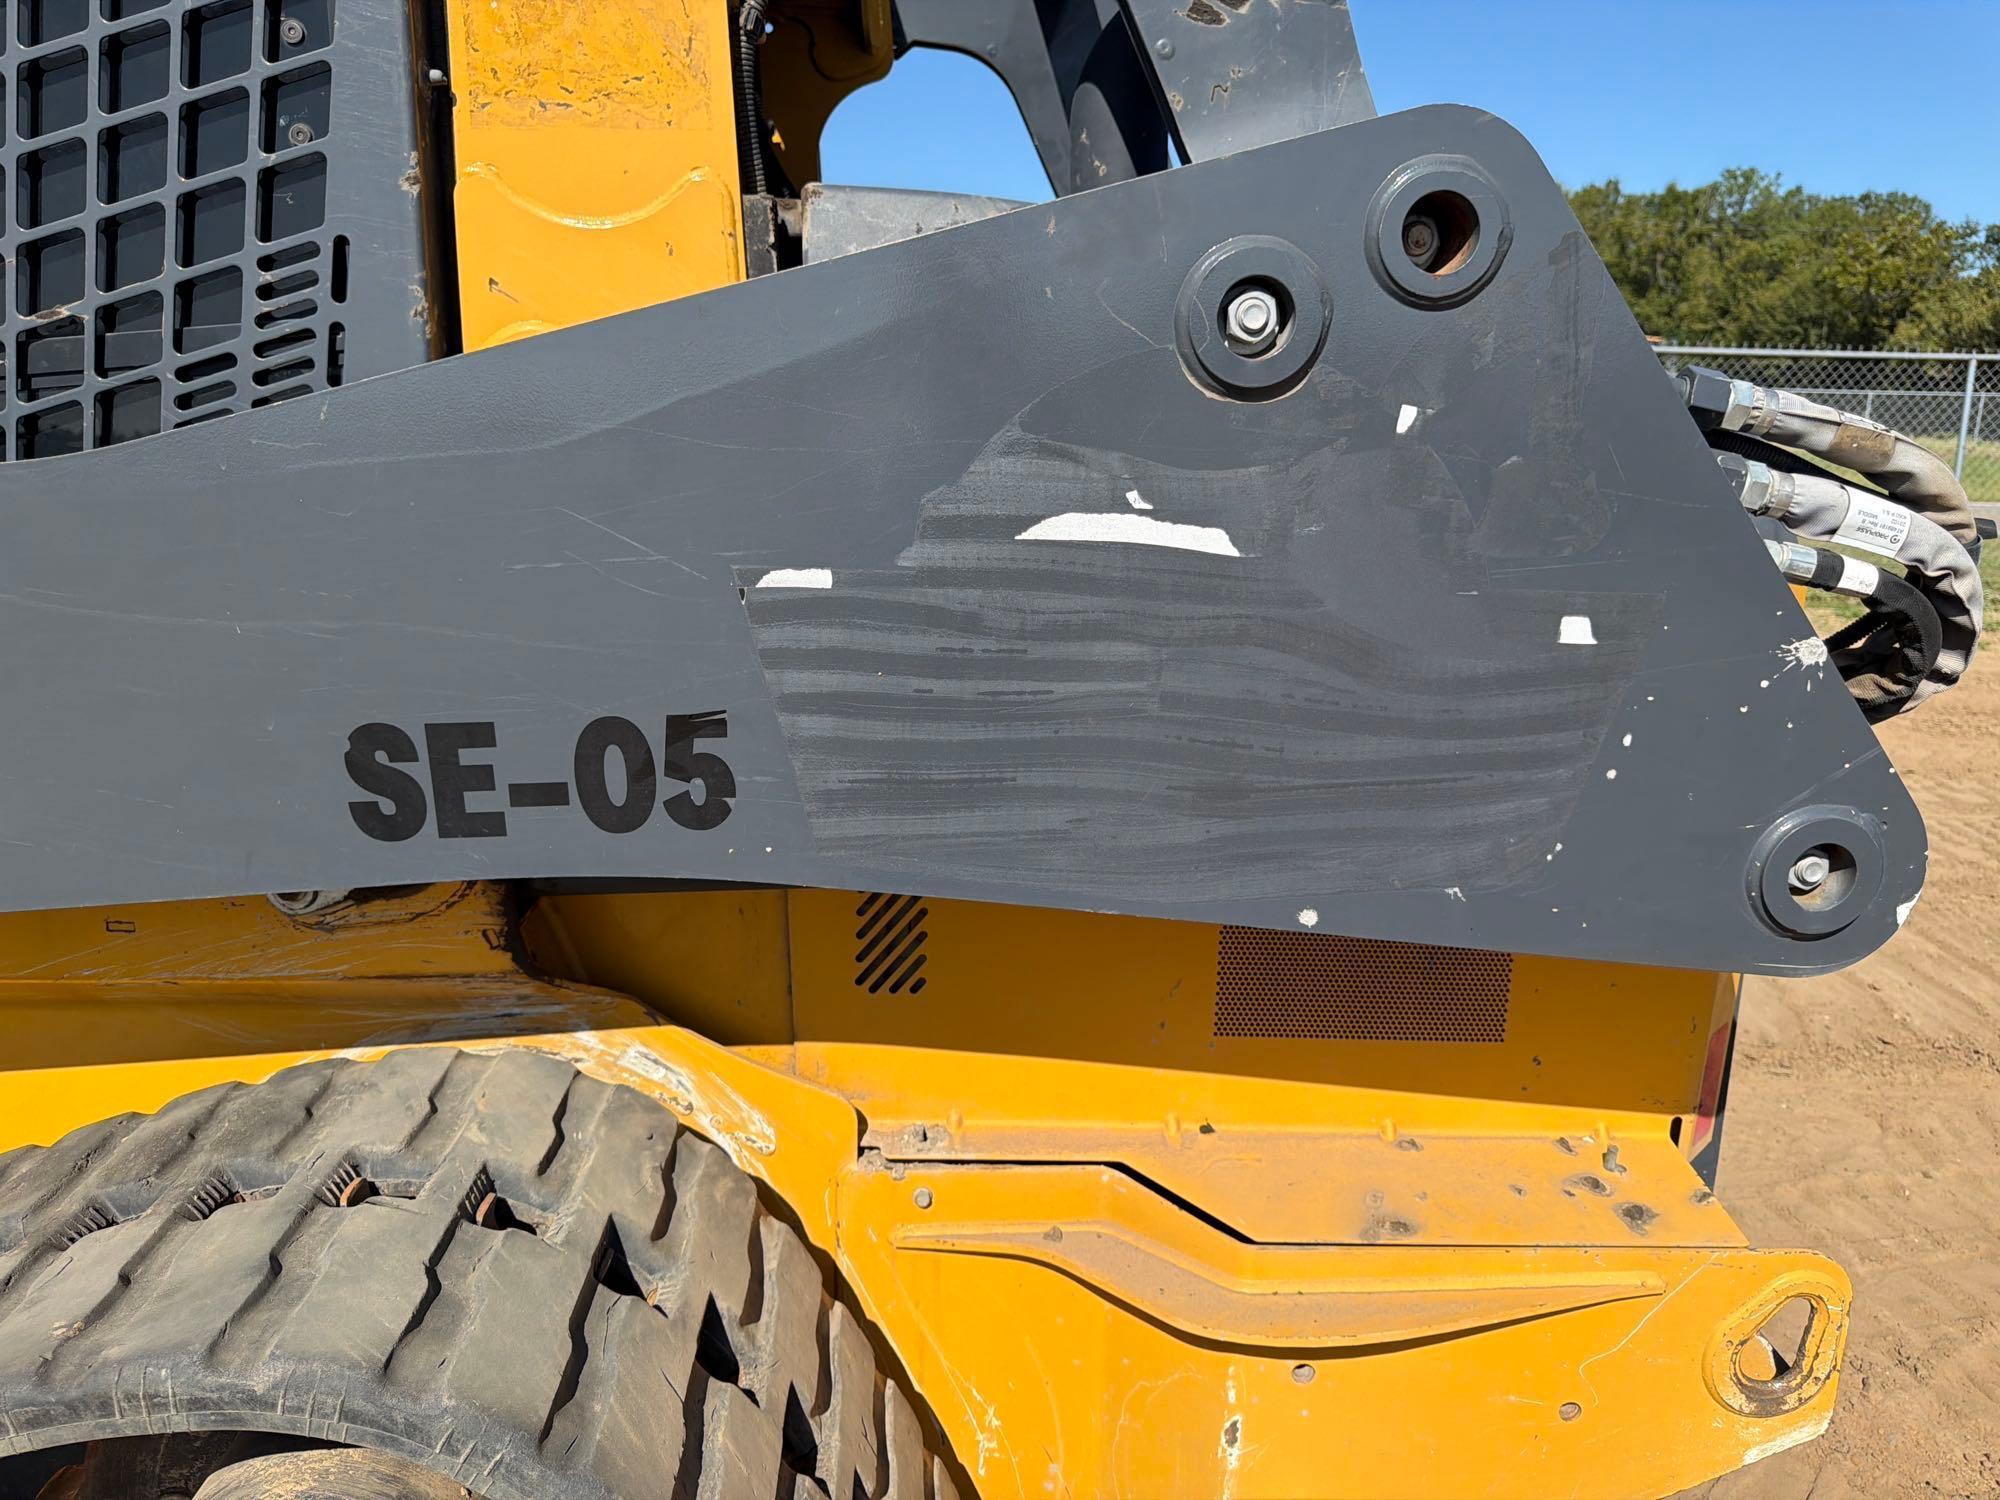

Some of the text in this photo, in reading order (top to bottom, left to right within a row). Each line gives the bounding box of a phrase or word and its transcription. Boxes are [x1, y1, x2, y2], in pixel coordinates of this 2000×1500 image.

[1857, 509, 1878, 520] MIDDLE
[1855, 526, 1890, 540] PROPULSE
[345, 710, 736, 842] SE-05
